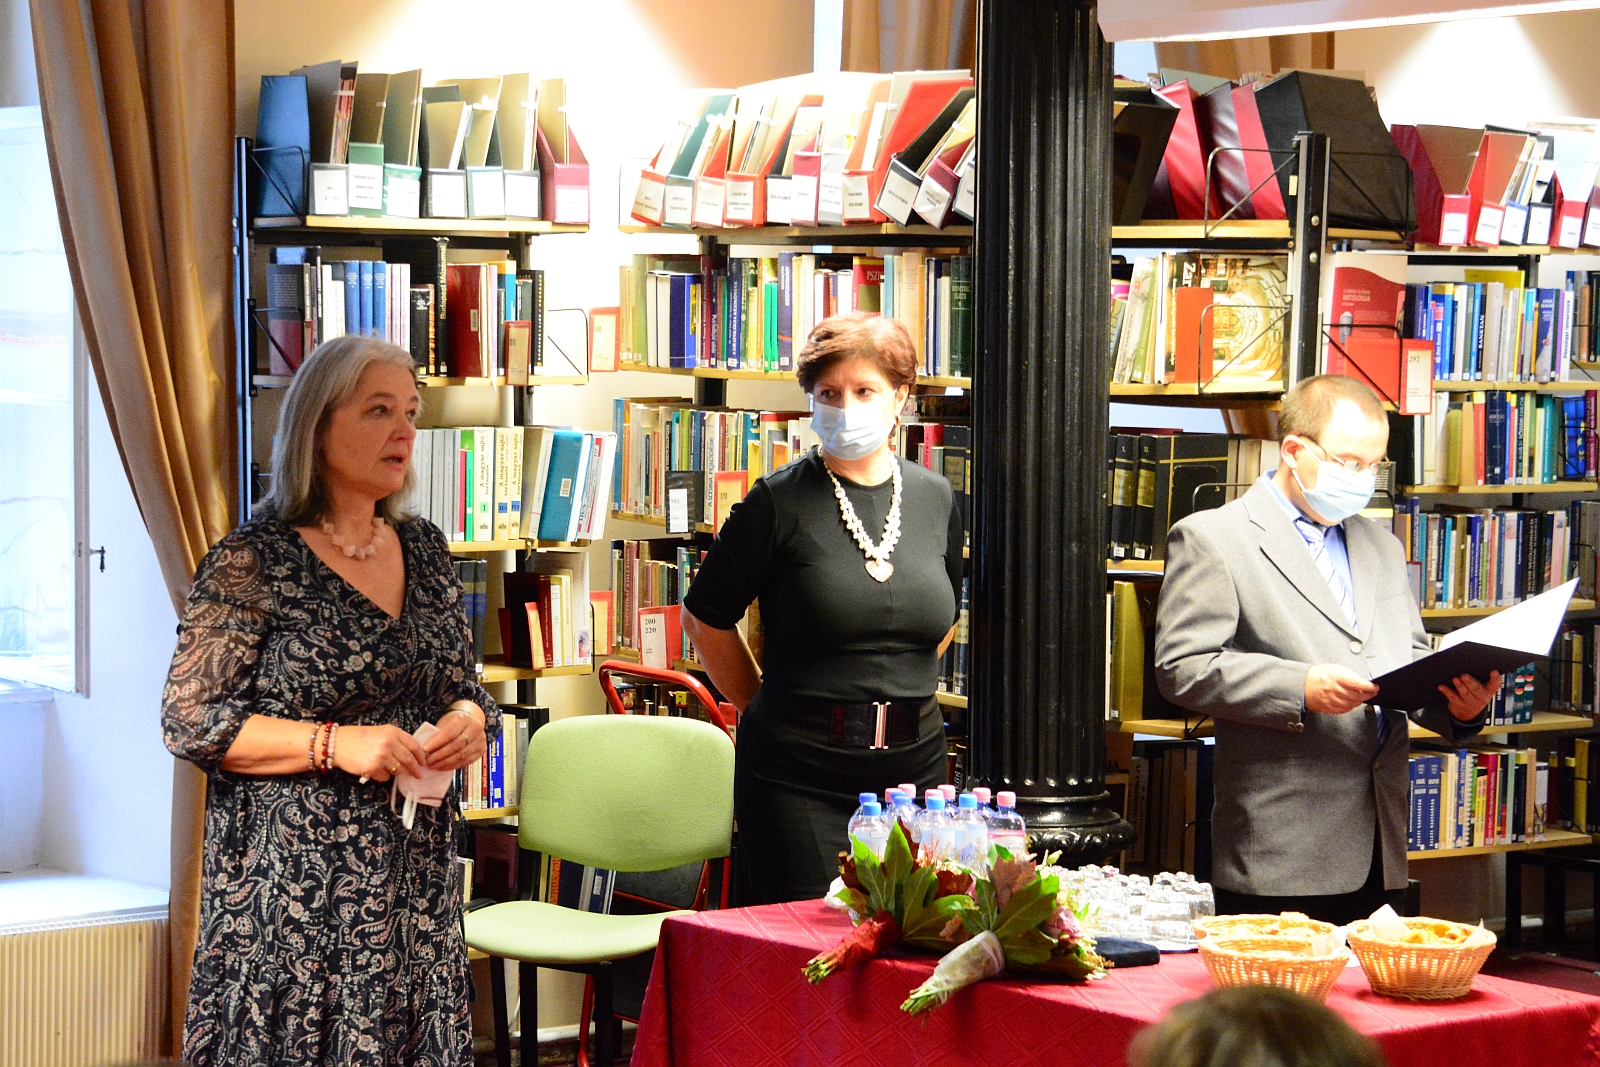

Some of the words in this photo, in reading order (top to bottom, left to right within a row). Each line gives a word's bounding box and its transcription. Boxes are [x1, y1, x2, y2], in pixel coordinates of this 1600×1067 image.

[1342, 294, 1371, 302] MITOLÓGIA
[438, 285, 448, 320] Budapest
[1408, 355, 1420, 363] 292
